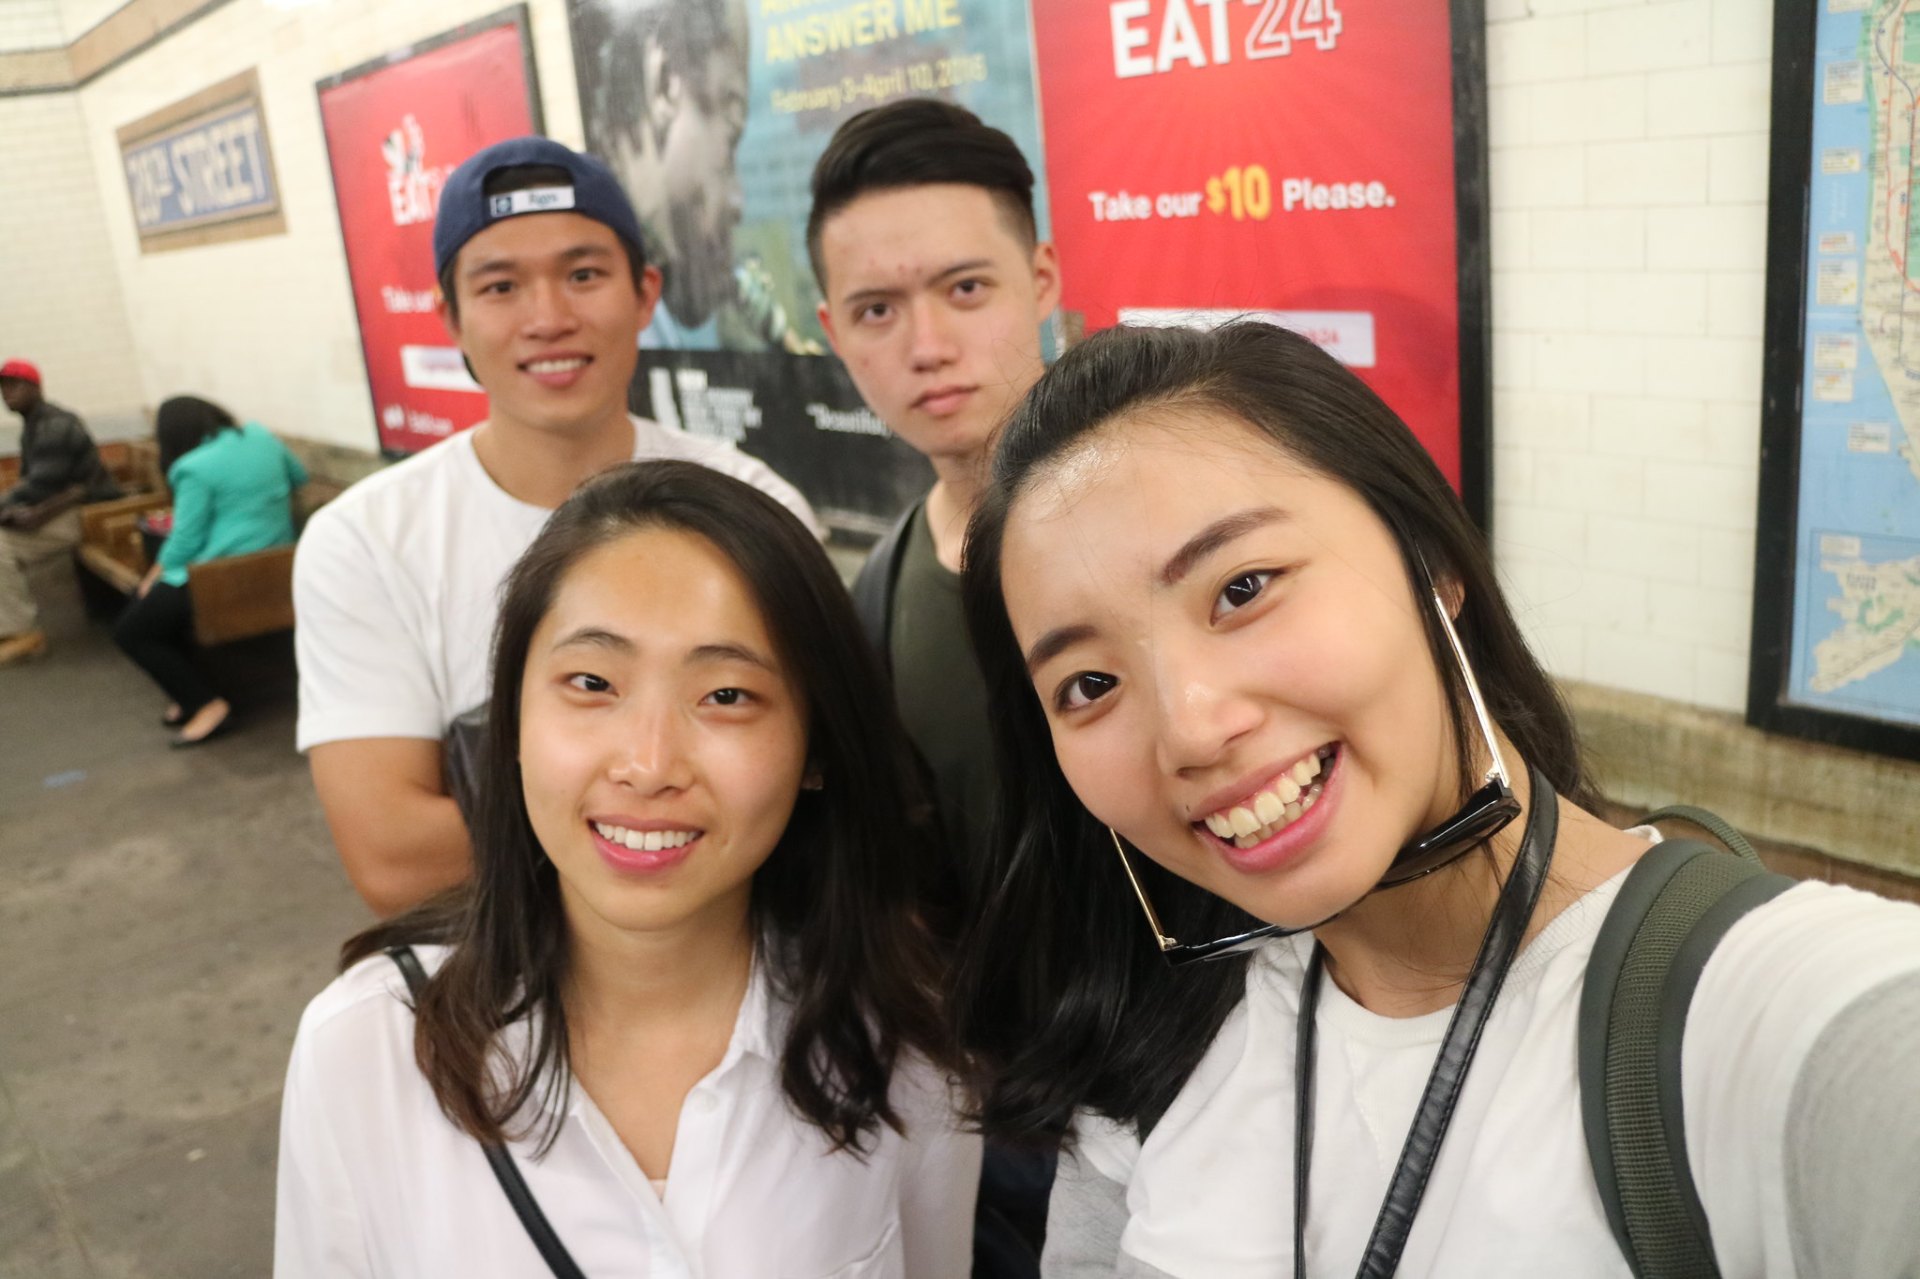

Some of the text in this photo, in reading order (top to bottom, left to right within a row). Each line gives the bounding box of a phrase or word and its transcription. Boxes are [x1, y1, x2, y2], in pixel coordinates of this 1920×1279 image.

[765, 0, 962, 63] ANSWER ME
[770, 86, 842, 113] February
[171, 112, 265, 216] STREET
[1088, 164, 1396, 222] Take our $10 Please.
